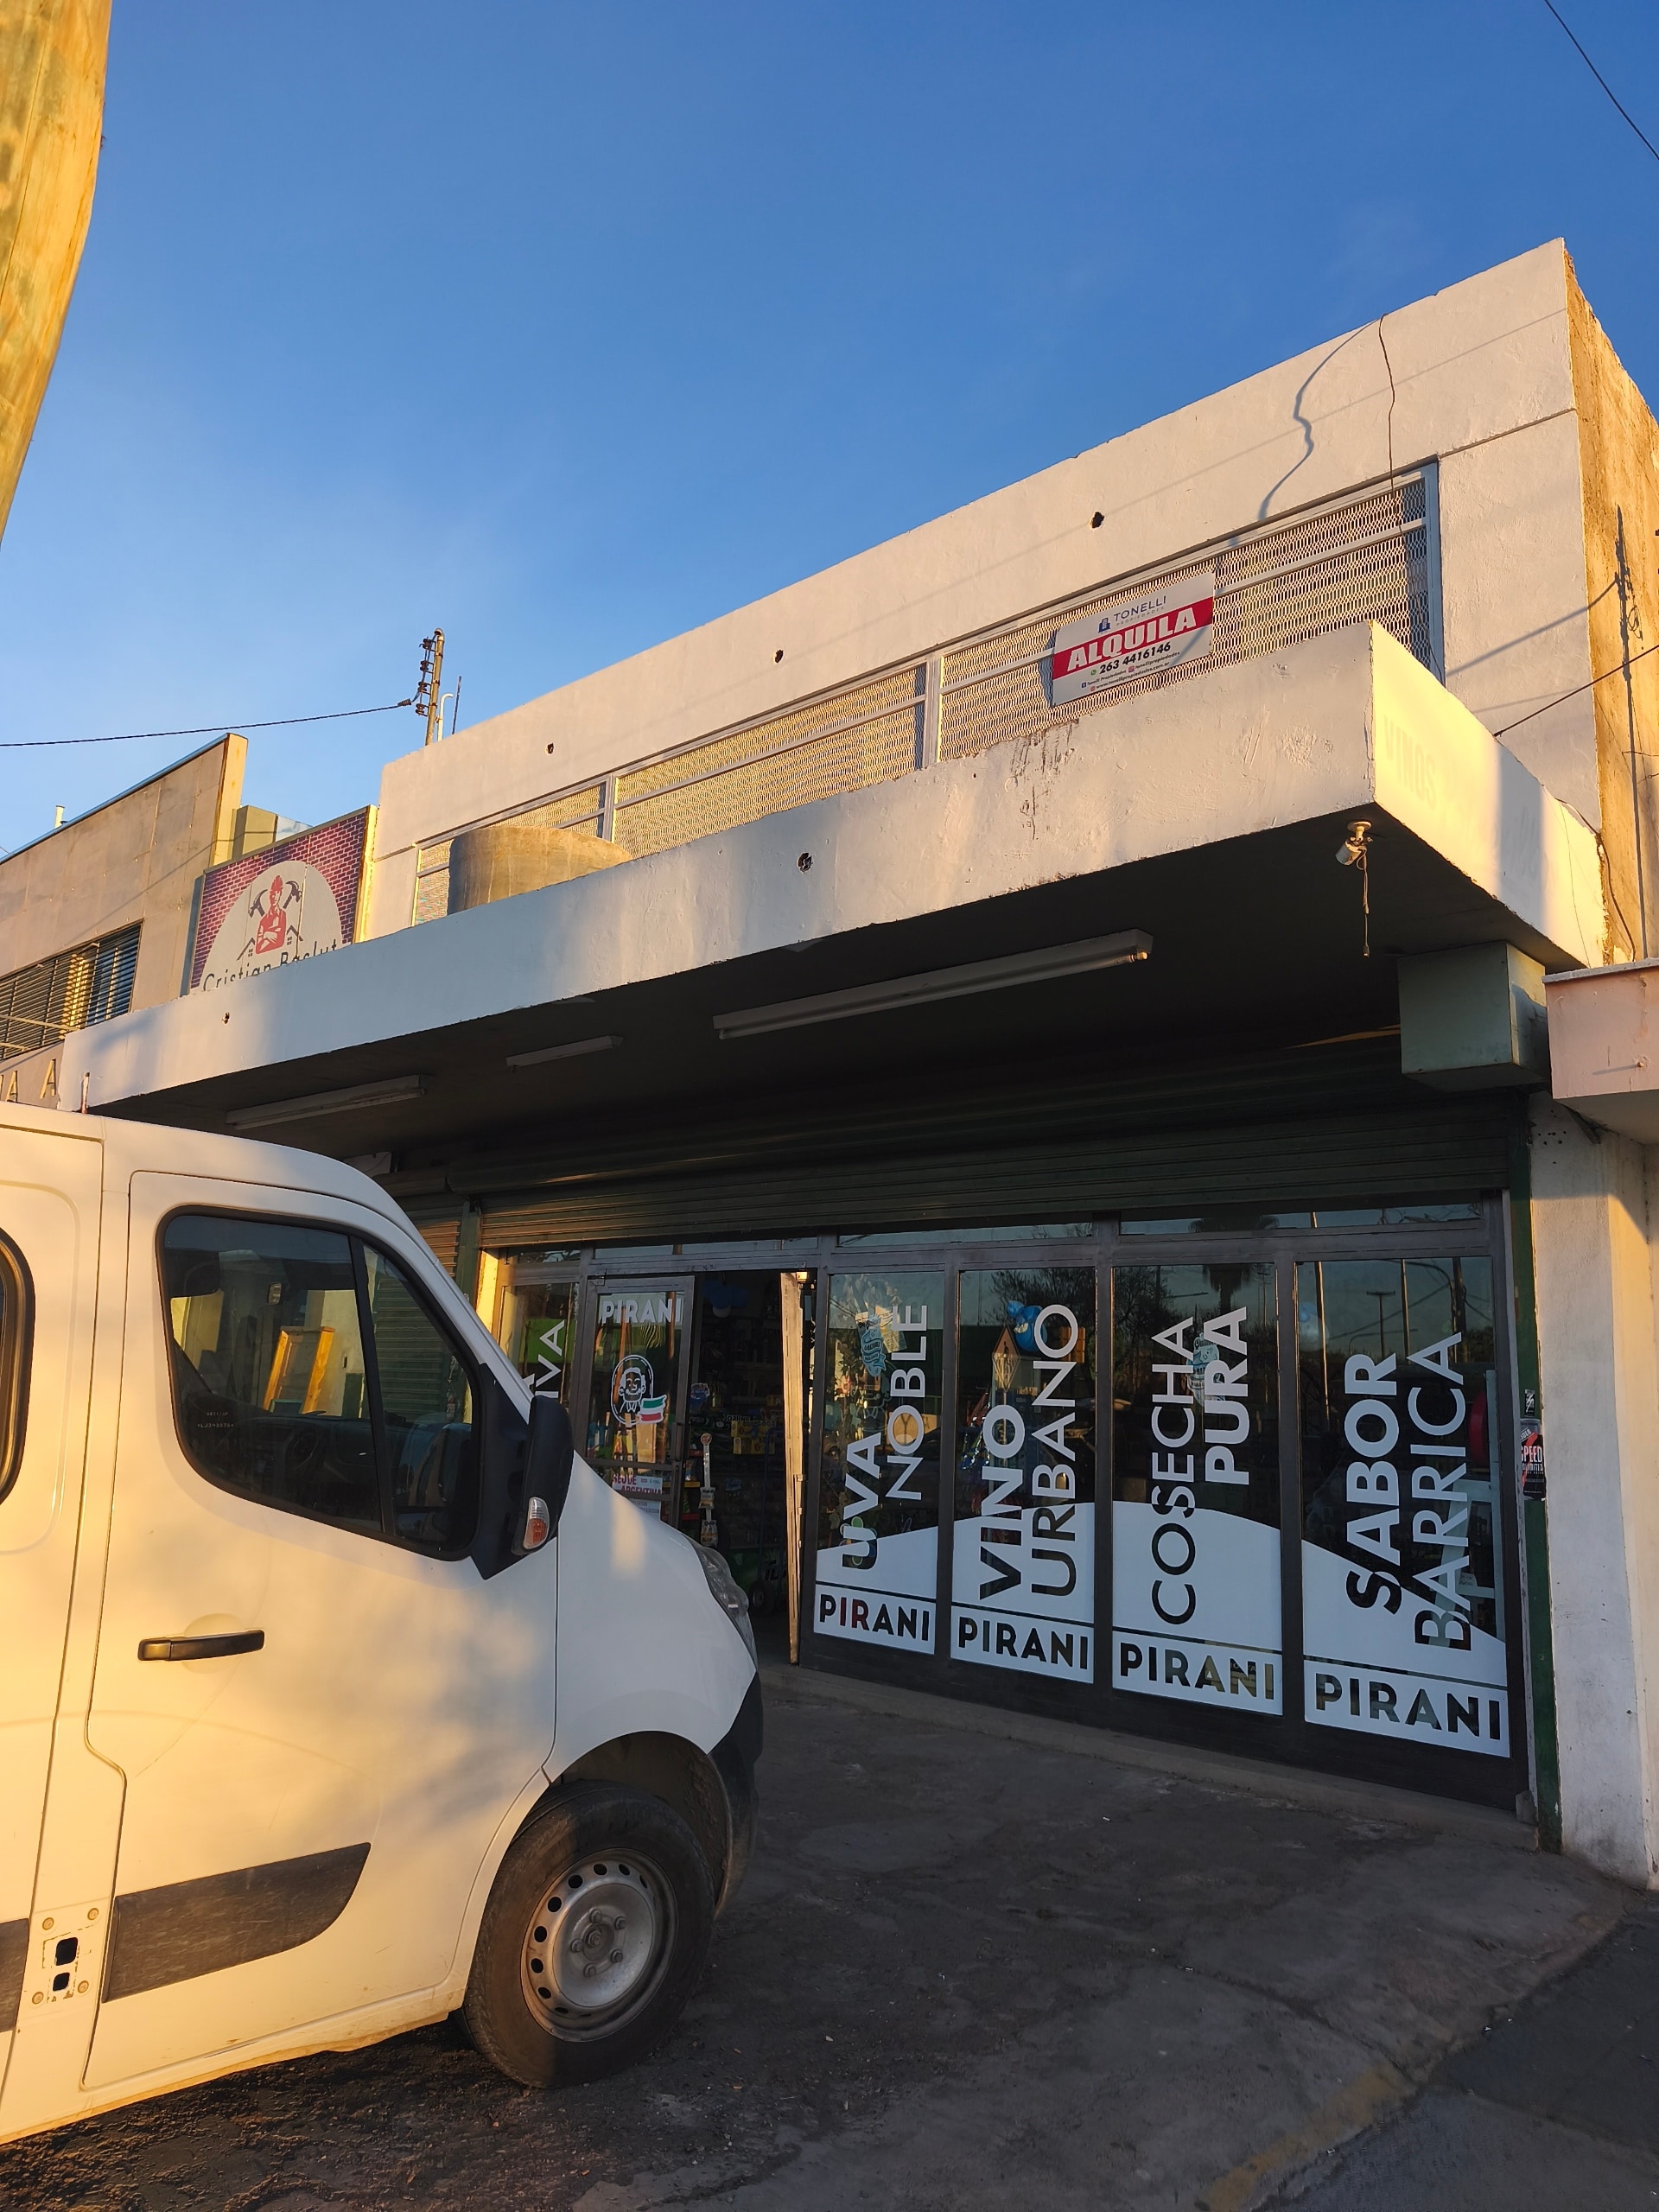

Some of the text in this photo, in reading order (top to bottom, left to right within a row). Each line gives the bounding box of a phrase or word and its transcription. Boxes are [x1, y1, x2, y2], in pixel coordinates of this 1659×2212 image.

[1067, 607, 1196, 672] ALQUILA
[1099, 641, 1171, 674] 263 4416146
[1114, 595, 1166, 622] TONELLI
[601, 1298, 682, 1324] PIRANI
[885, 1305, 927, 1500] NOBLE
[1203, 1306, 1250, 1485] PURA
[842, 1433, 882, 1571] UVA
[980, 1404, 1026, 1600] VINO
[1031, 1304, 1078, 1597] URBANO
[1151, 1317, 1196, 1625] COSECHA
[1344, 1352, 1402, 1616] SABOR
[1407, 1332, 1472, 1652] BARRICA
[819, 1594, 930, 1642] PIRANI
[958, 1617, 1089, 1671] PIRANI
[1120, 1643, 1274, 1700] PIRANI
[1315, 1672, 1501, 1740] PIRANI
